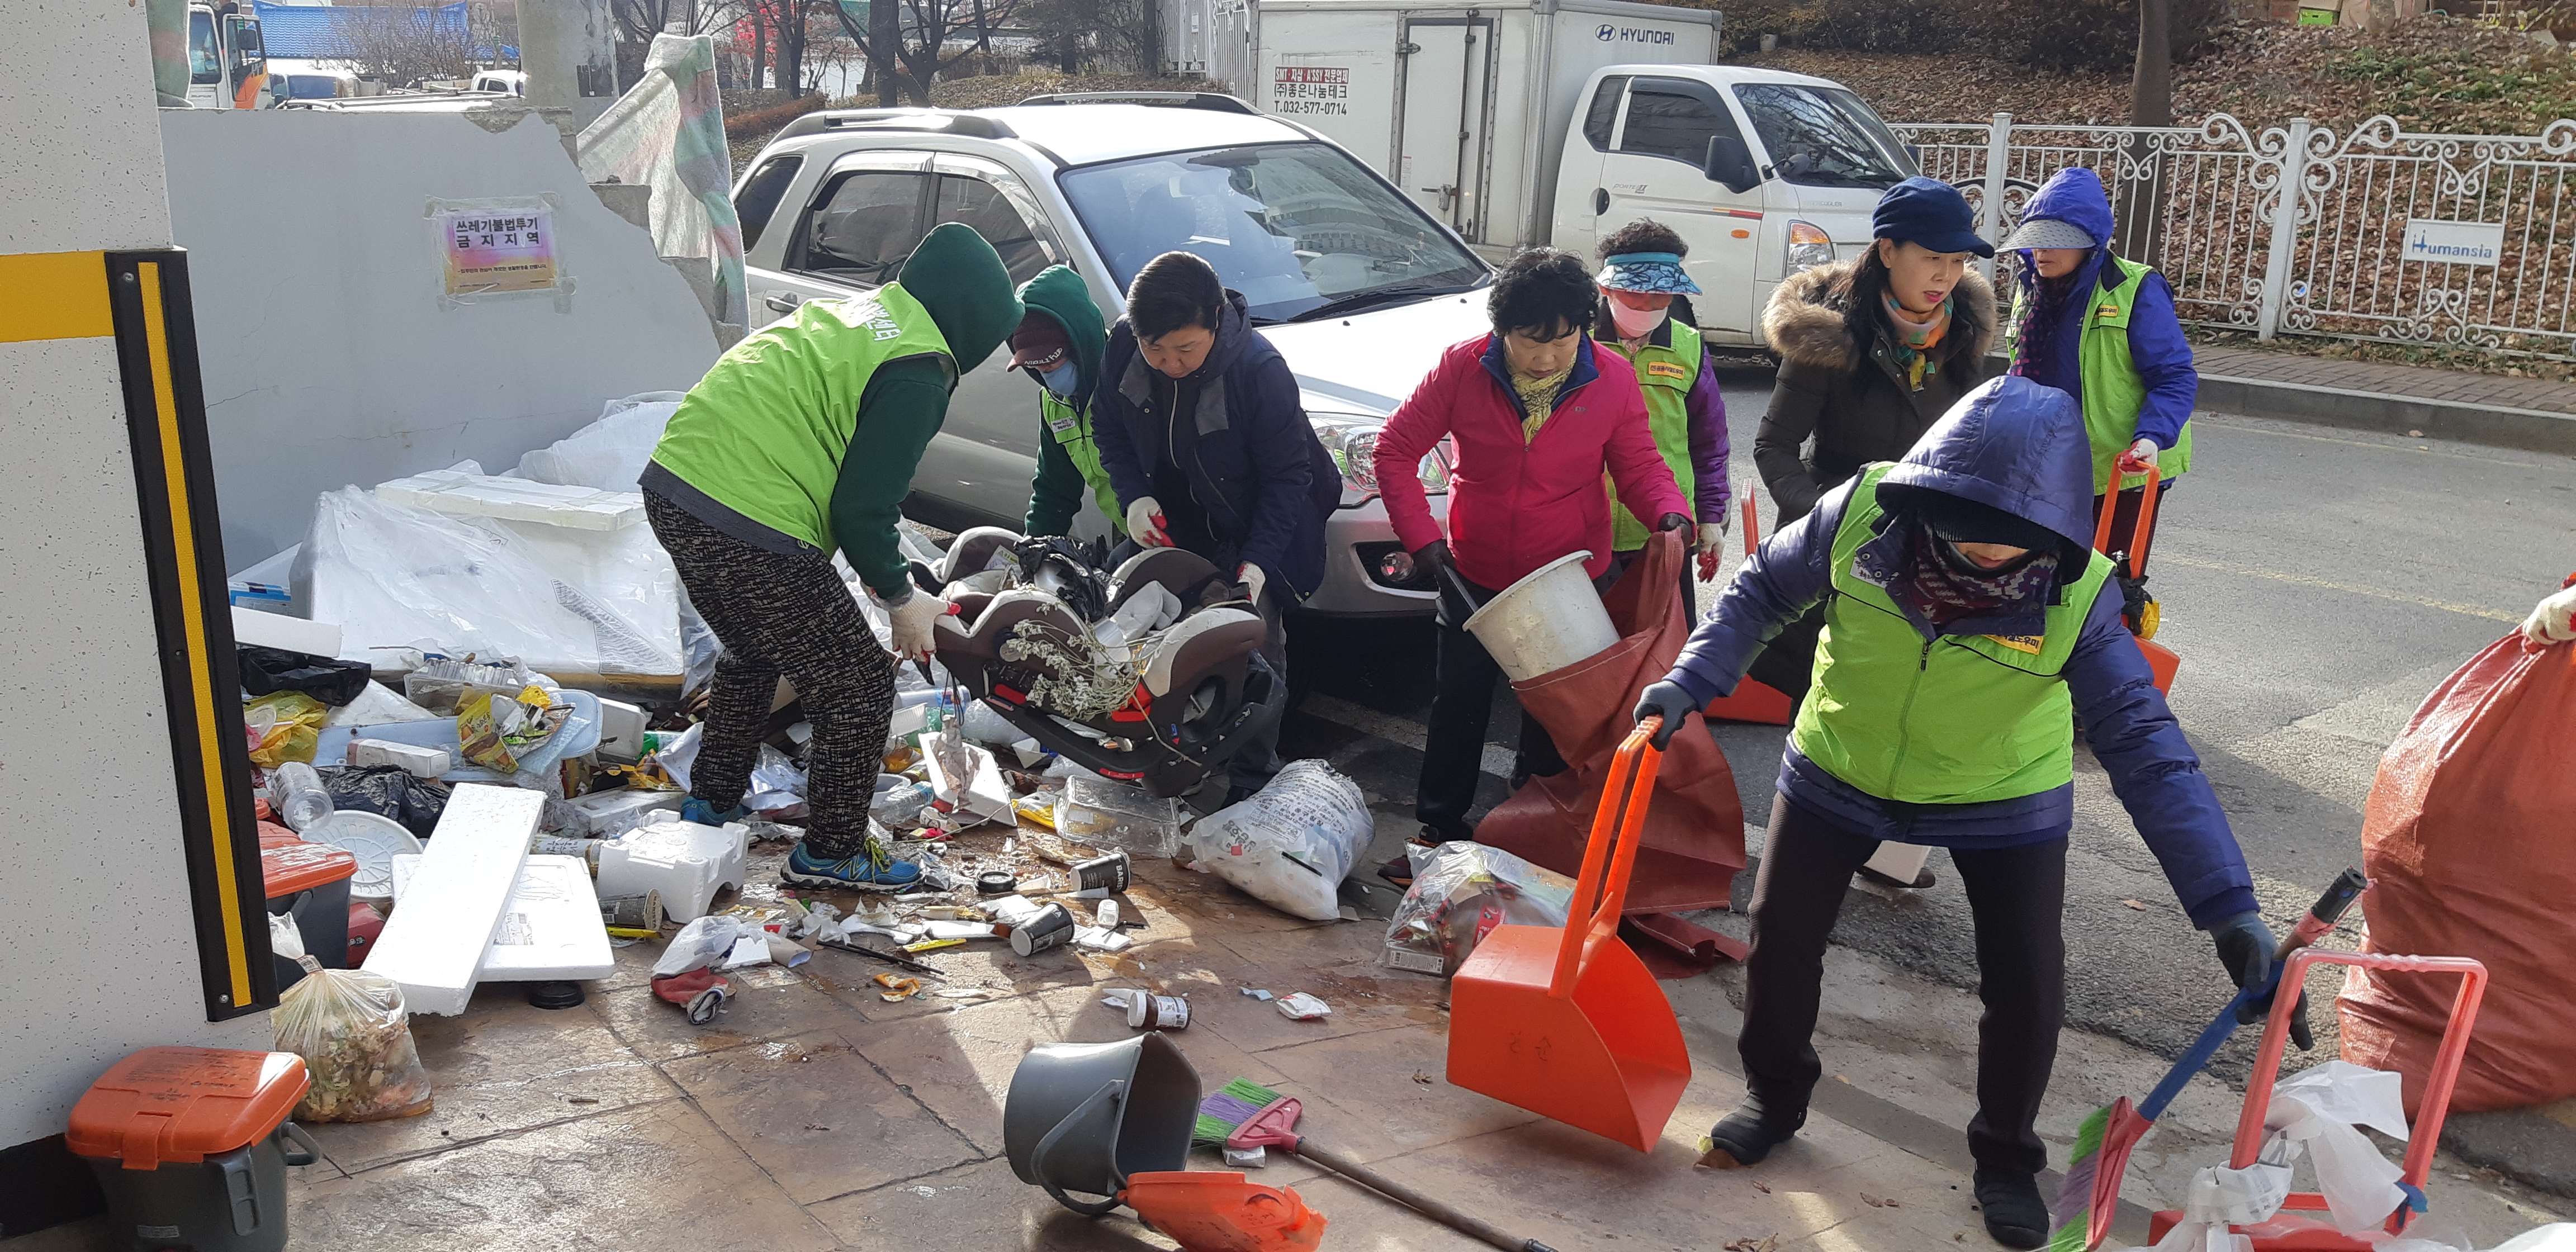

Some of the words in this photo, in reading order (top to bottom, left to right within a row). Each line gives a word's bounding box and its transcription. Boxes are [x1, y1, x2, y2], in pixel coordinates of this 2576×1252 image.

[1621, 27, 1675, 45] HYUNDAI
[1274, 83, 1347, 99] (주)좋은나눔테크
[1274, 100, 1347, 116] T.032-577-0714
[456, 217, 538, 233] 쓰레기불법투기
[2412, 229, 2492, 258] Humansia
